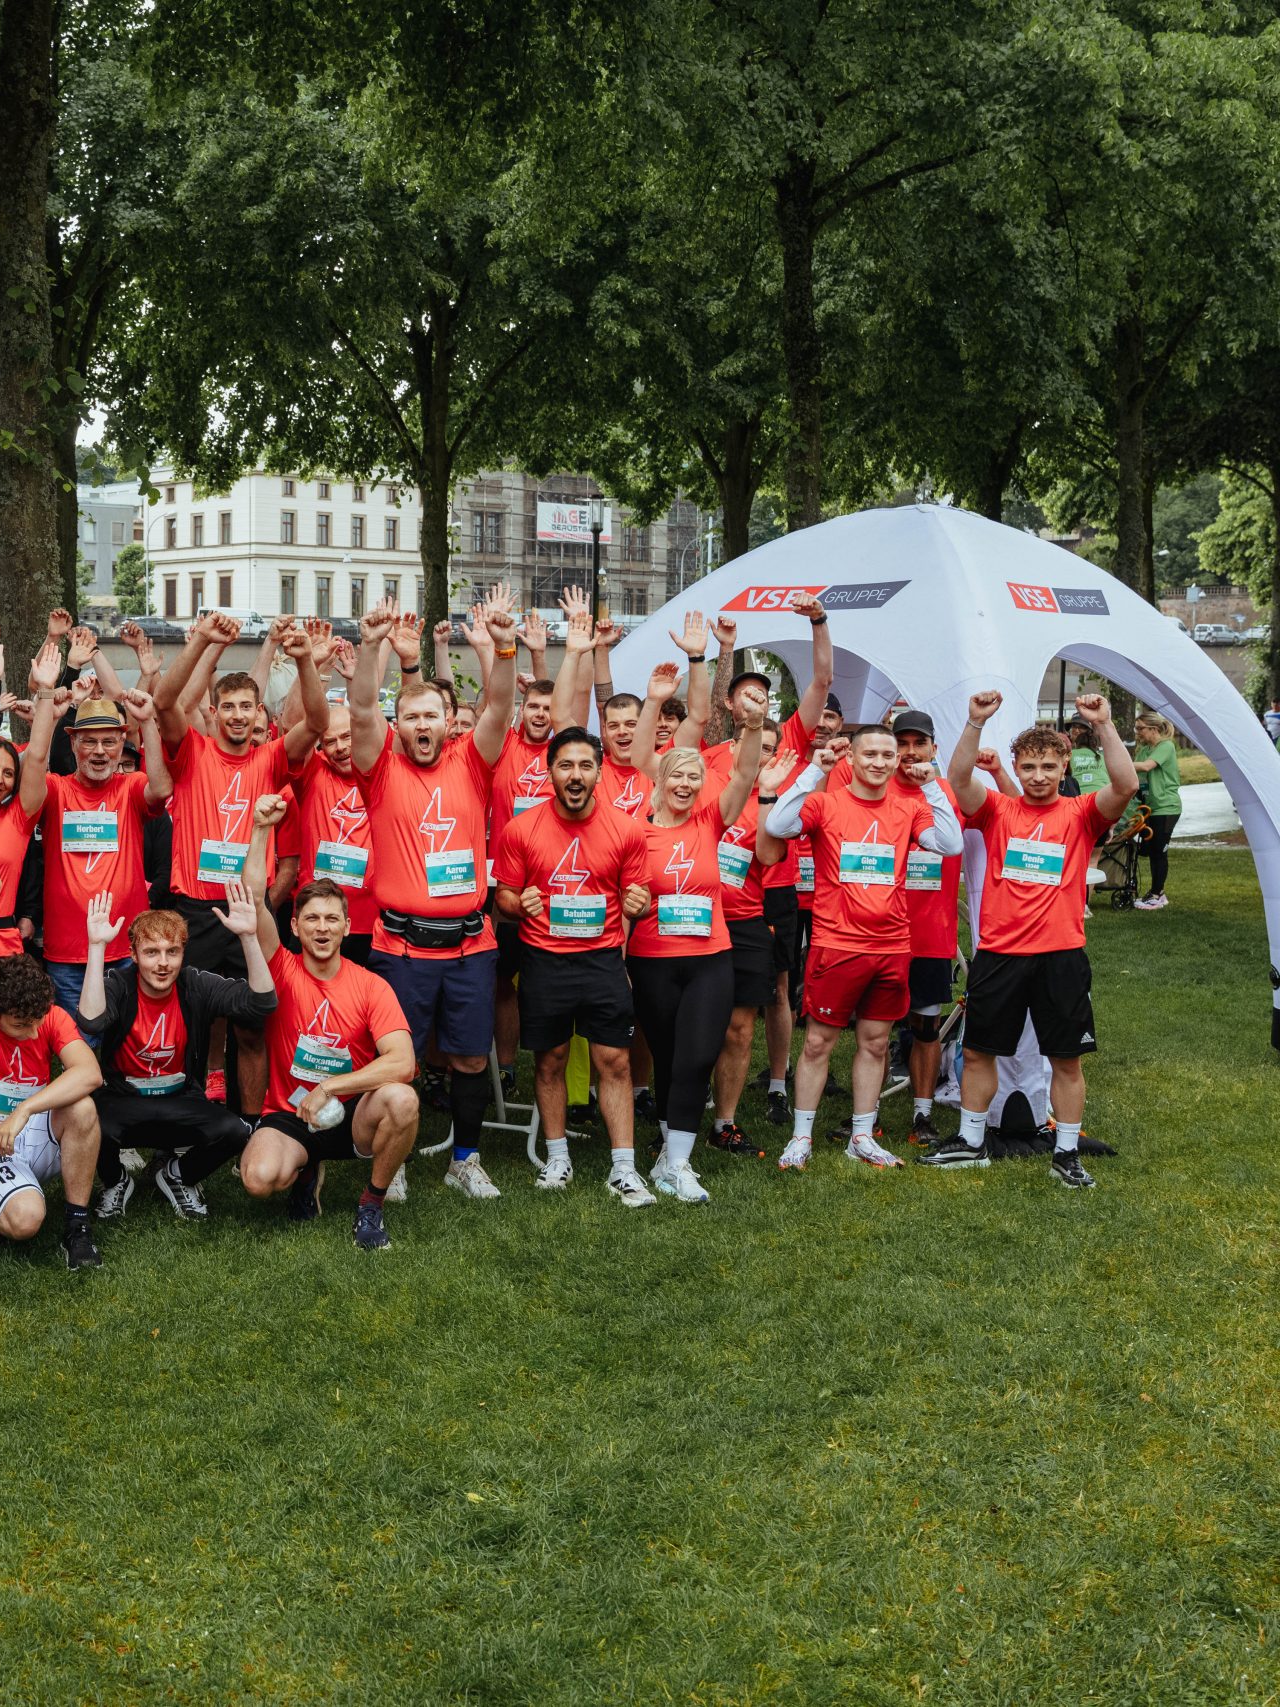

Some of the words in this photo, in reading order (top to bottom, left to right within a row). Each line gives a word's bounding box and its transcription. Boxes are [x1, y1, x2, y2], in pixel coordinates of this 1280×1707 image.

[824, 588, 891, 604] GRUPPE
[1009, 585, 1055, 609] VSE
[1059, 594, 1104, 608] GRUPPE
[76, 824, 104, 833] Herbert
[219, 855, 239, 866] Timo
[329, 856, 348, 867] Sven
[861, 856, 878, 866] Gleb
[1022, 853, 1045, 865] Denis
[445, 866, 467, 875] Aaron
[563, 909, 596, 918] Batuhan
[673, 906, 702, 917] Kathrin
[302, 1053, 345, 1068] Alexander
